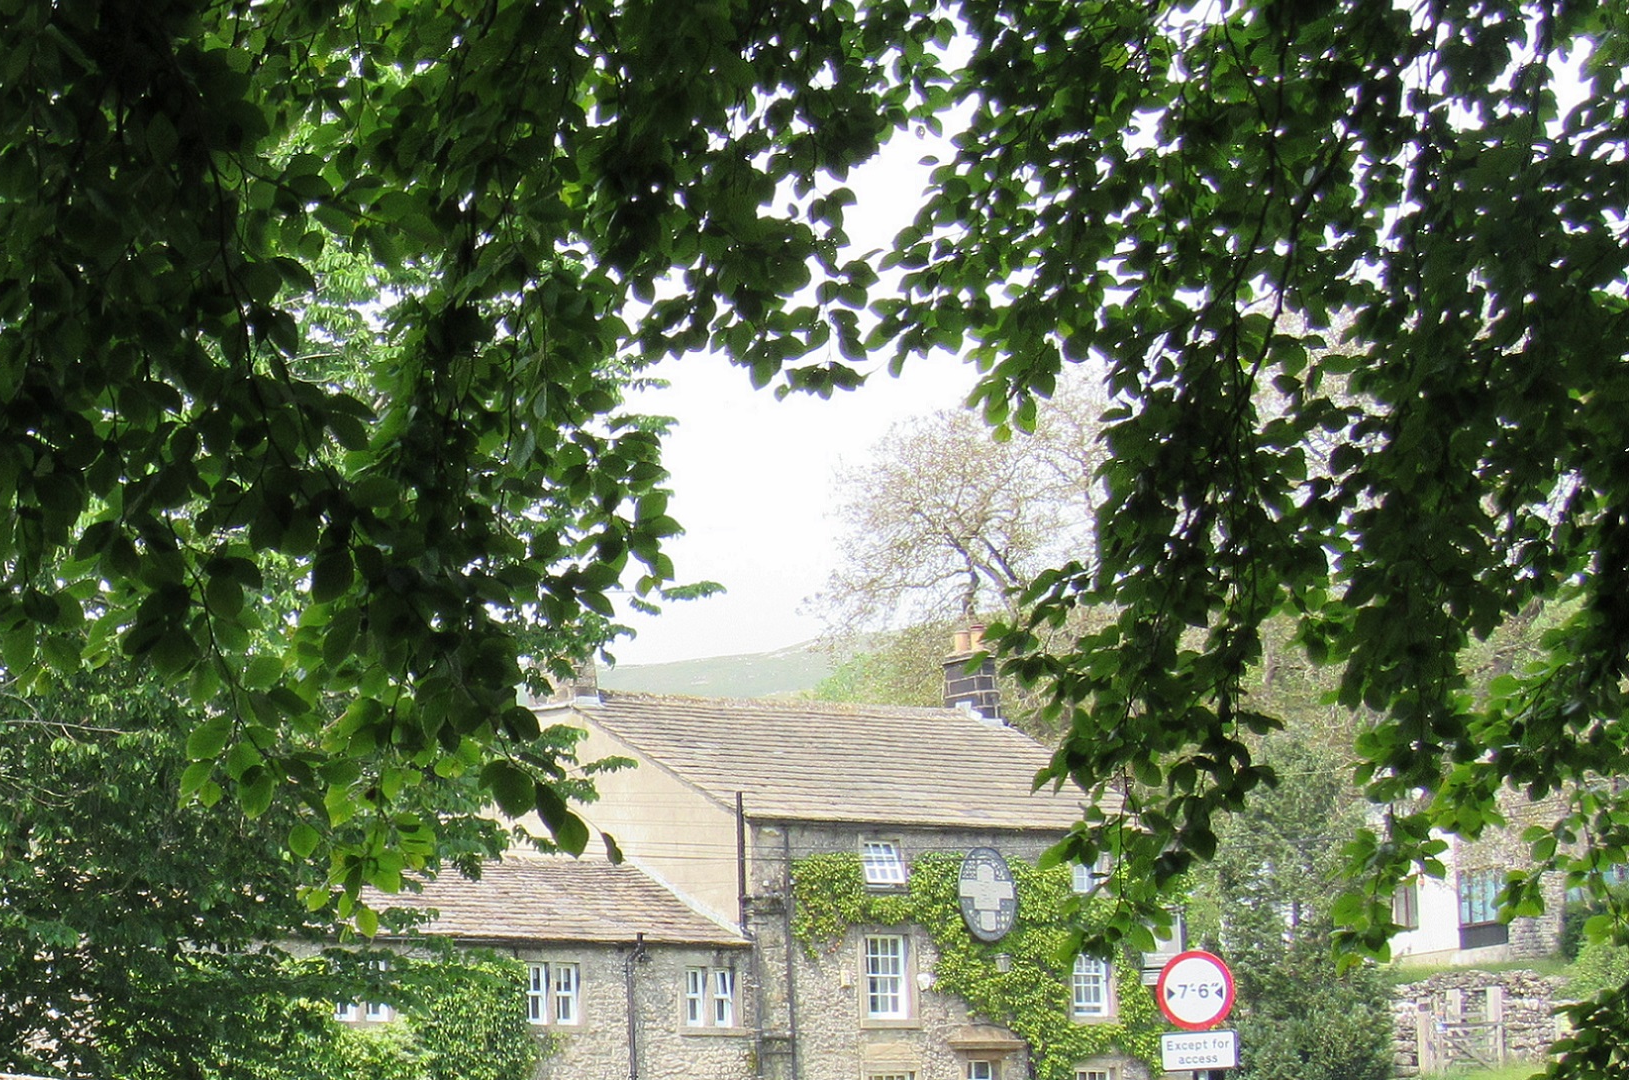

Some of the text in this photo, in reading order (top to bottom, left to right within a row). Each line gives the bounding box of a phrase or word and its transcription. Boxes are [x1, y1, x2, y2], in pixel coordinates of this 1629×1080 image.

[1166, 1038, 1230, 1051] Except for
[1178, 1055, 1218, 1065] access
